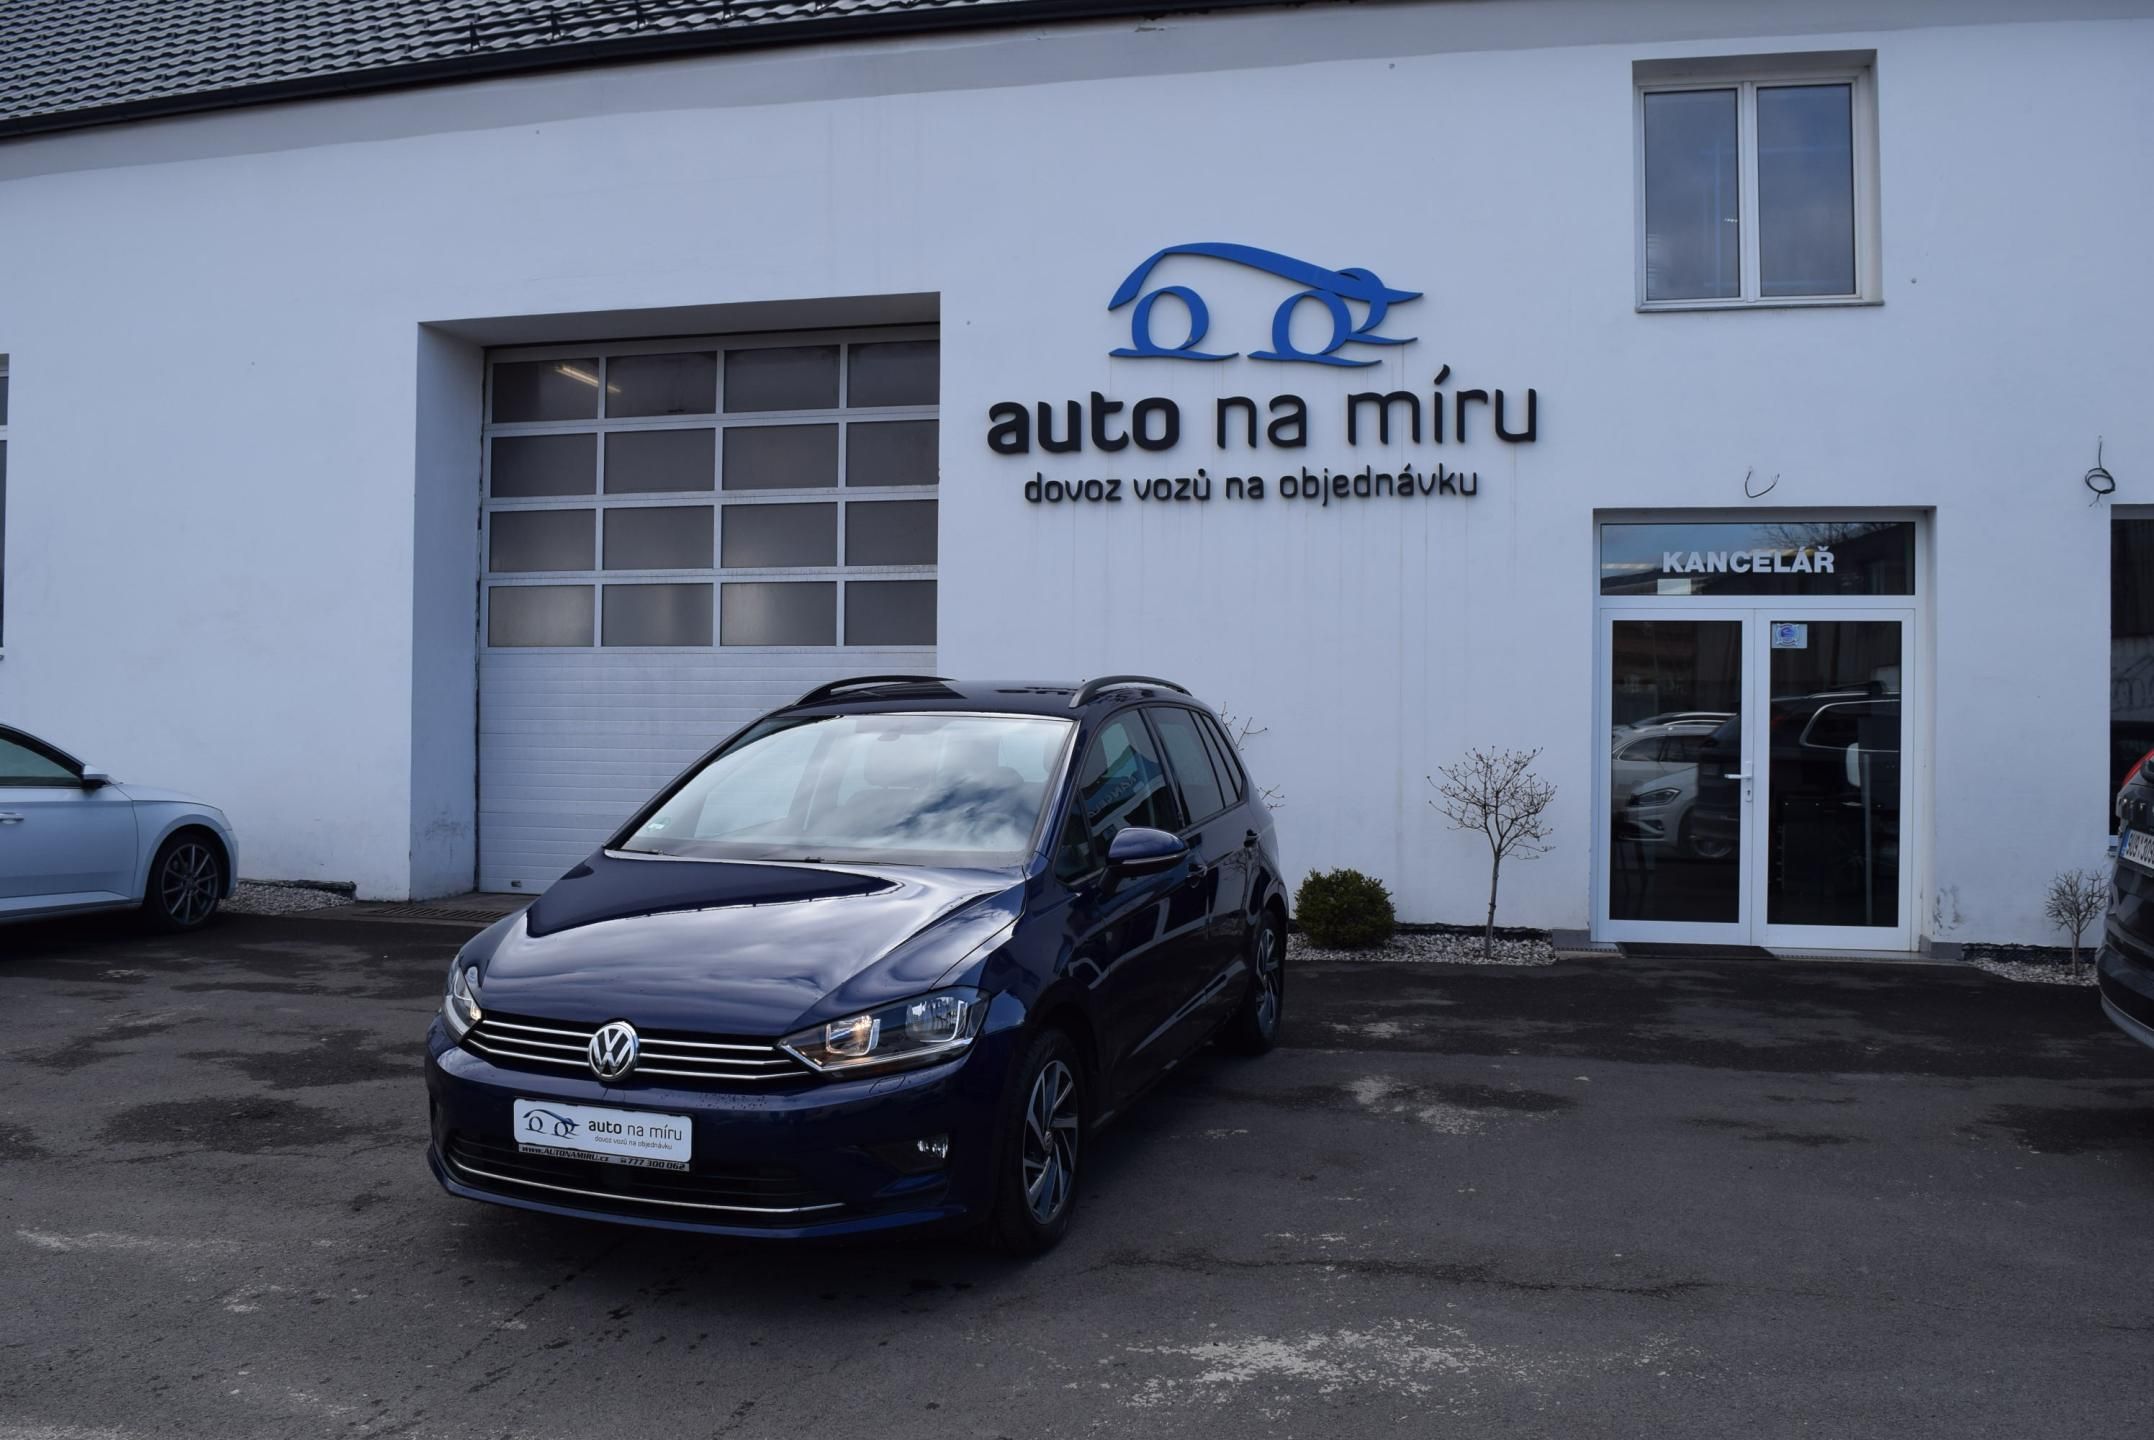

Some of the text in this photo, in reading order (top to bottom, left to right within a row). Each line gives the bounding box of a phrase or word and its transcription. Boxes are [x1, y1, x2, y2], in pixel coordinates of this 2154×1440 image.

[988, 364, 1537, 455] auto na míru
[1025, 463, 1478, 506] dovoz vozů na objednávku
[1662, 546, 1835, 574] KANCELÁŘ
[588, 1120, 682, 1141] auto na míru
